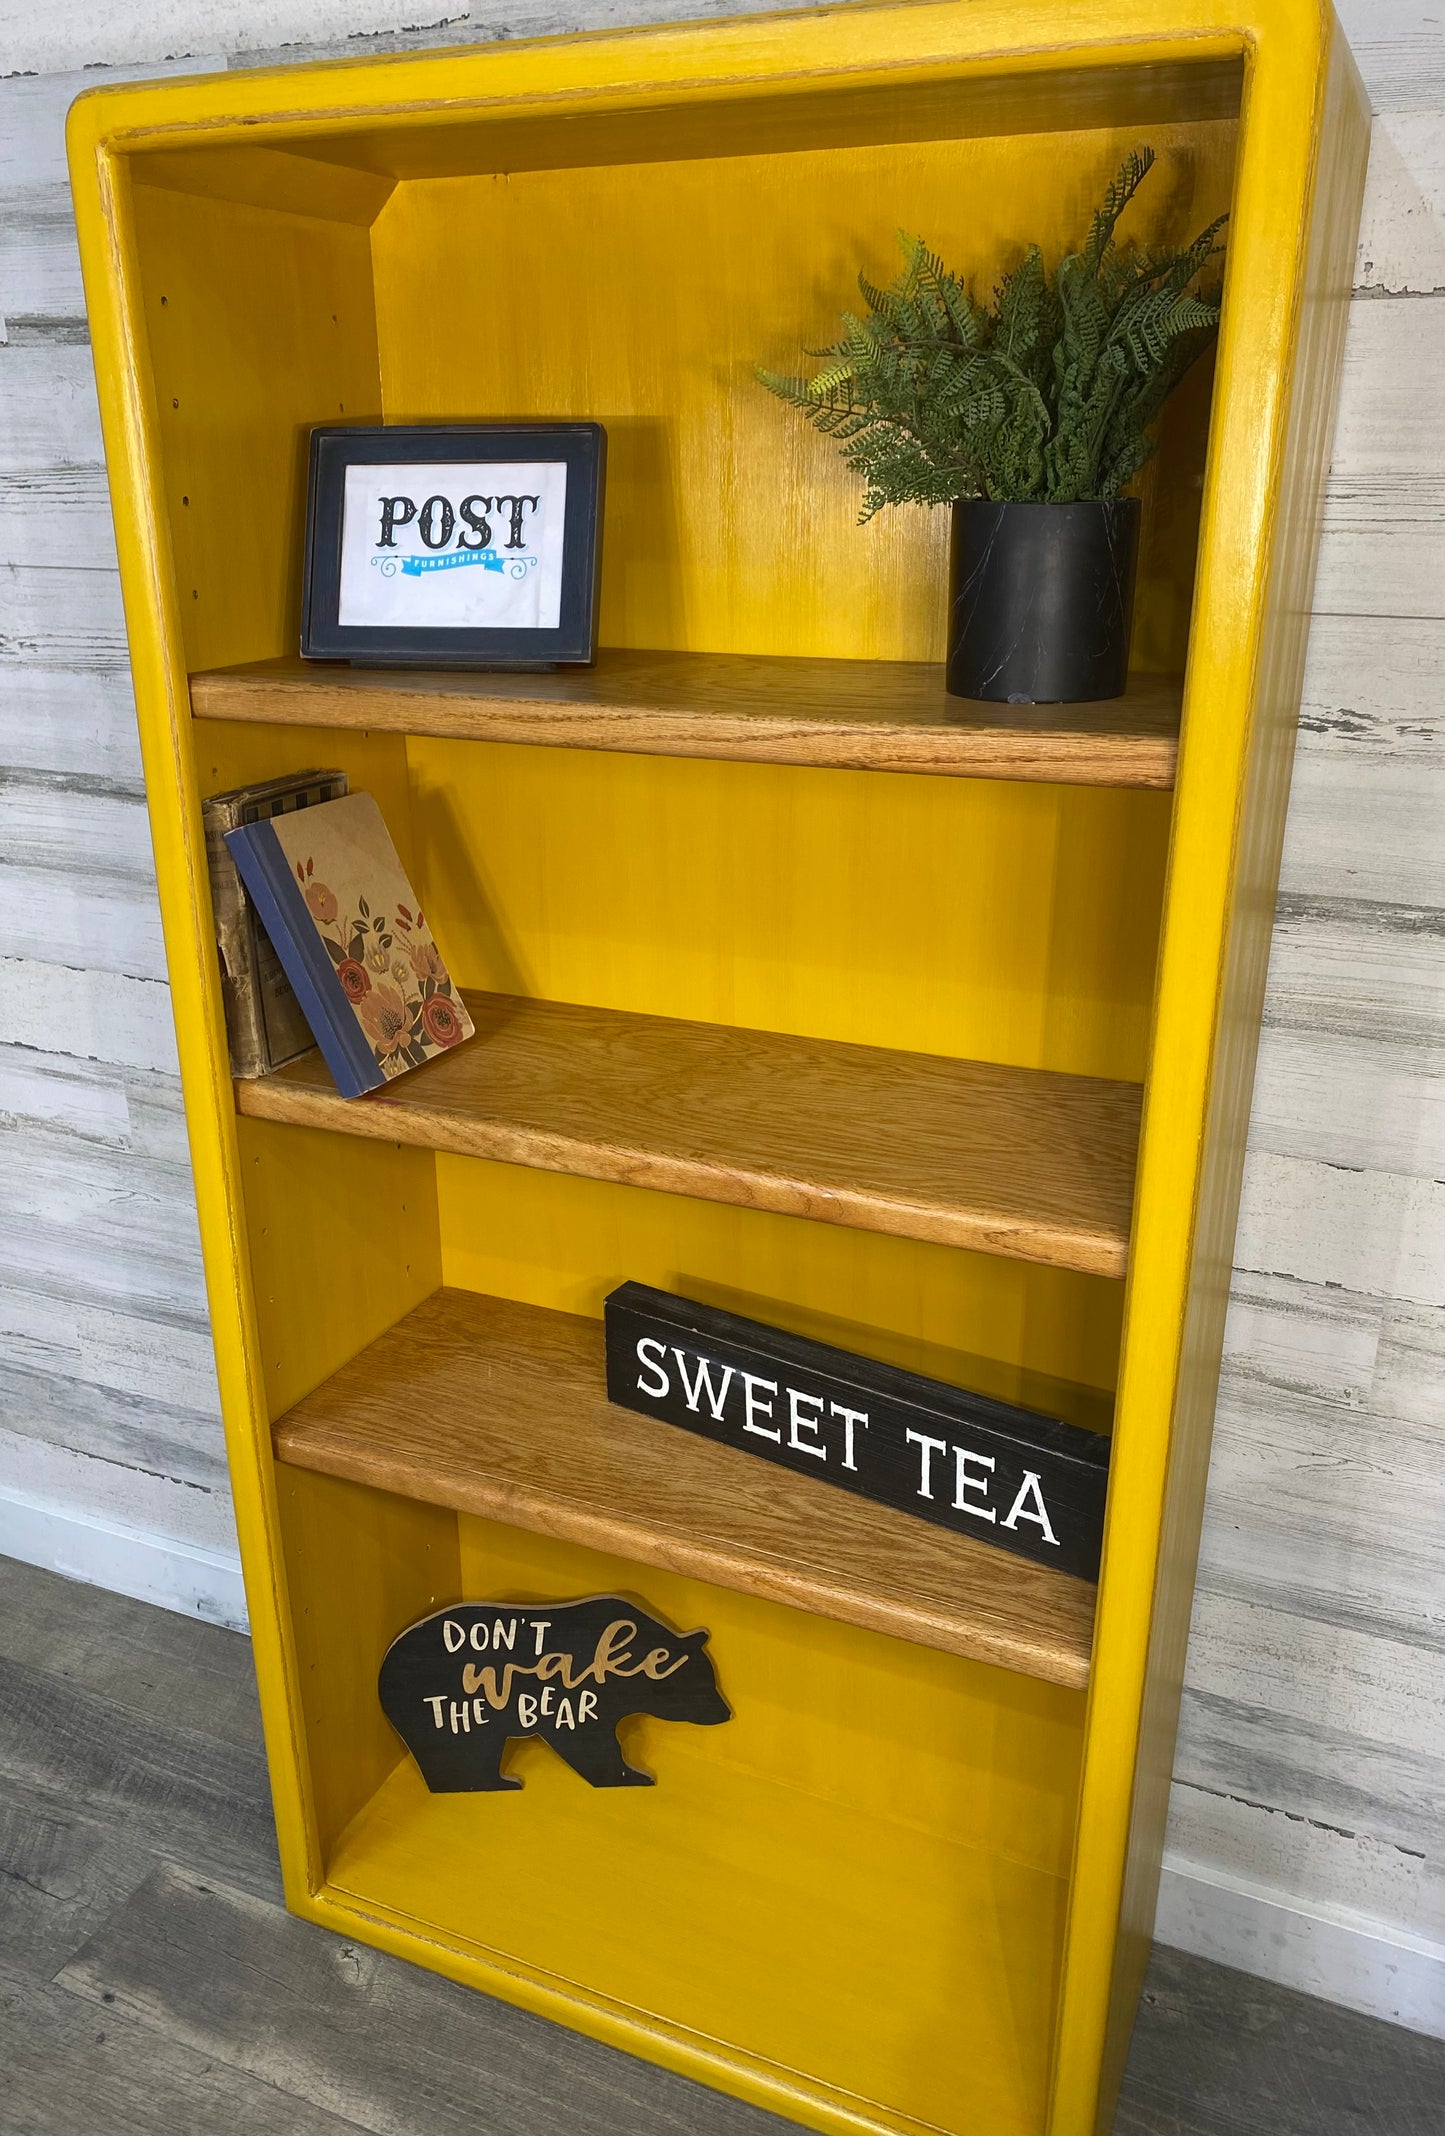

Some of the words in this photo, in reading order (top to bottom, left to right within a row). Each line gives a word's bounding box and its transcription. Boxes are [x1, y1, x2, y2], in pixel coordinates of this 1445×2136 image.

[375, 494, 541, 550] POST
[414, 552, 495, 568] FURNISHINGS
[635, 1337, 869, 1472] SWEET
[905, 1427, 1061, 1547] TEA
[442, 1617, 552, 1656] DON'T
[462, 1619, 689, 1710] wake
[422, 1694, 490, 1735] THE
[517, 1686, 600, 1731] BEAR
